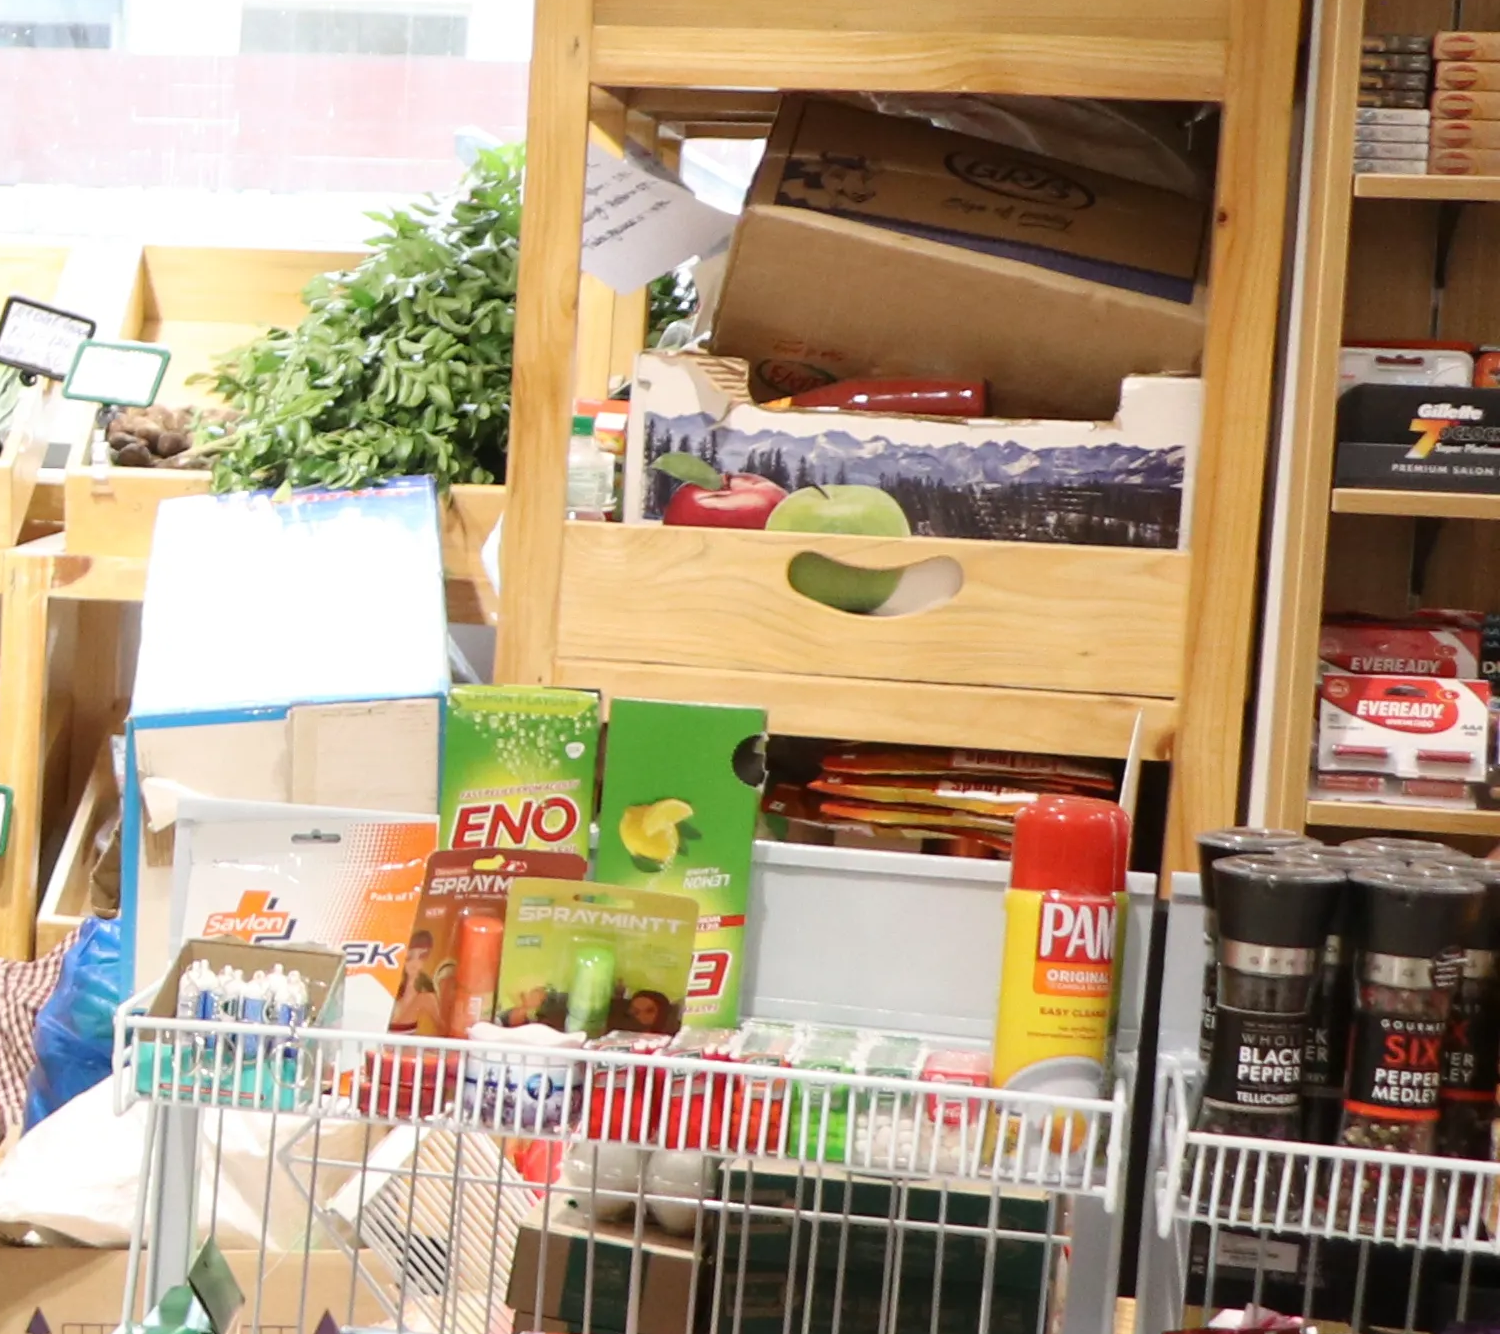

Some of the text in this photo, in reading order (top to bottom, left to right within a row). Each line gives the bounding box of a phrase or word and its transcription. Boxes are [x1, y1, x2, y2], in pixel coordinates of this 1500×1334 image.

[1417, 404, 1483, 422] Gillette
[1405, 418, 1443, 459] 7
[1391, 463, 1493, 477] PREMIUM SALON
[1351, 656, 1440, 675] EVEREADY
[1356, 700, 1443, 722] EVEREADY
[450, 794, 579, 851] ENO
[429, 875, 510, 898] SPRAYM
[683, 871, 731, 890] LEMON
[369, 890, 393, 902] Pack
[204, 912, 285, 936] Savlon
[518, 905, 689, 933] SPRAYMINTT
[1040, 898, 1117, 962] PAM
[343, 942, 401, 967] SK
[1038, 1005, 1064, 1018] EASY
[1238, 1045, 1302, 1066] BLACK
[1383, 1033, 1441, 1066] SIX
[1236, 1064, 1299, 1084] PEPPER
[1373, 1067, 1441, 1087] PEPPER
[1370, 1085, 1438, 1105] MEDLEY
